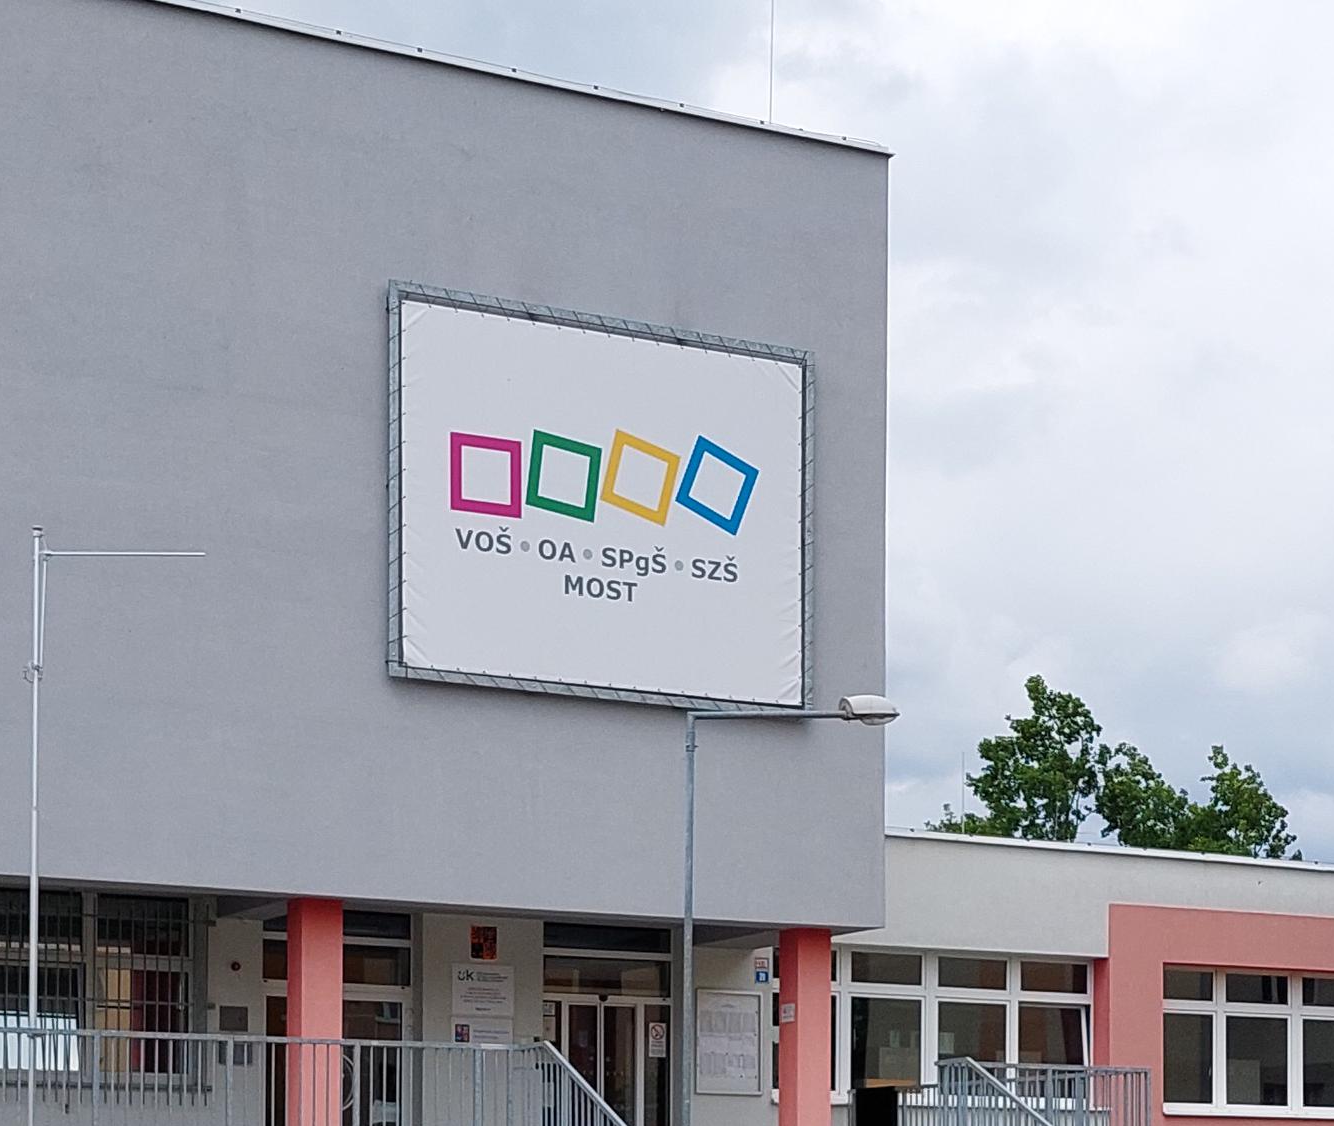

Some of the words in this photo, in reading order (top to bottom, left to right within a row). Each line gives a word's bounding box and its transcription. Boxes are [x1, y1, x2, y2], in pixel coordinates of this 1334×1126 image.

[455, 526, 512, 554] VOŠ
[538, 539, 576, 563] OA
[601, 545, 667, 577] SPgŠ
[691, 556, 738, 583] SZŠ
[564, 574, 638, 602] MOST
